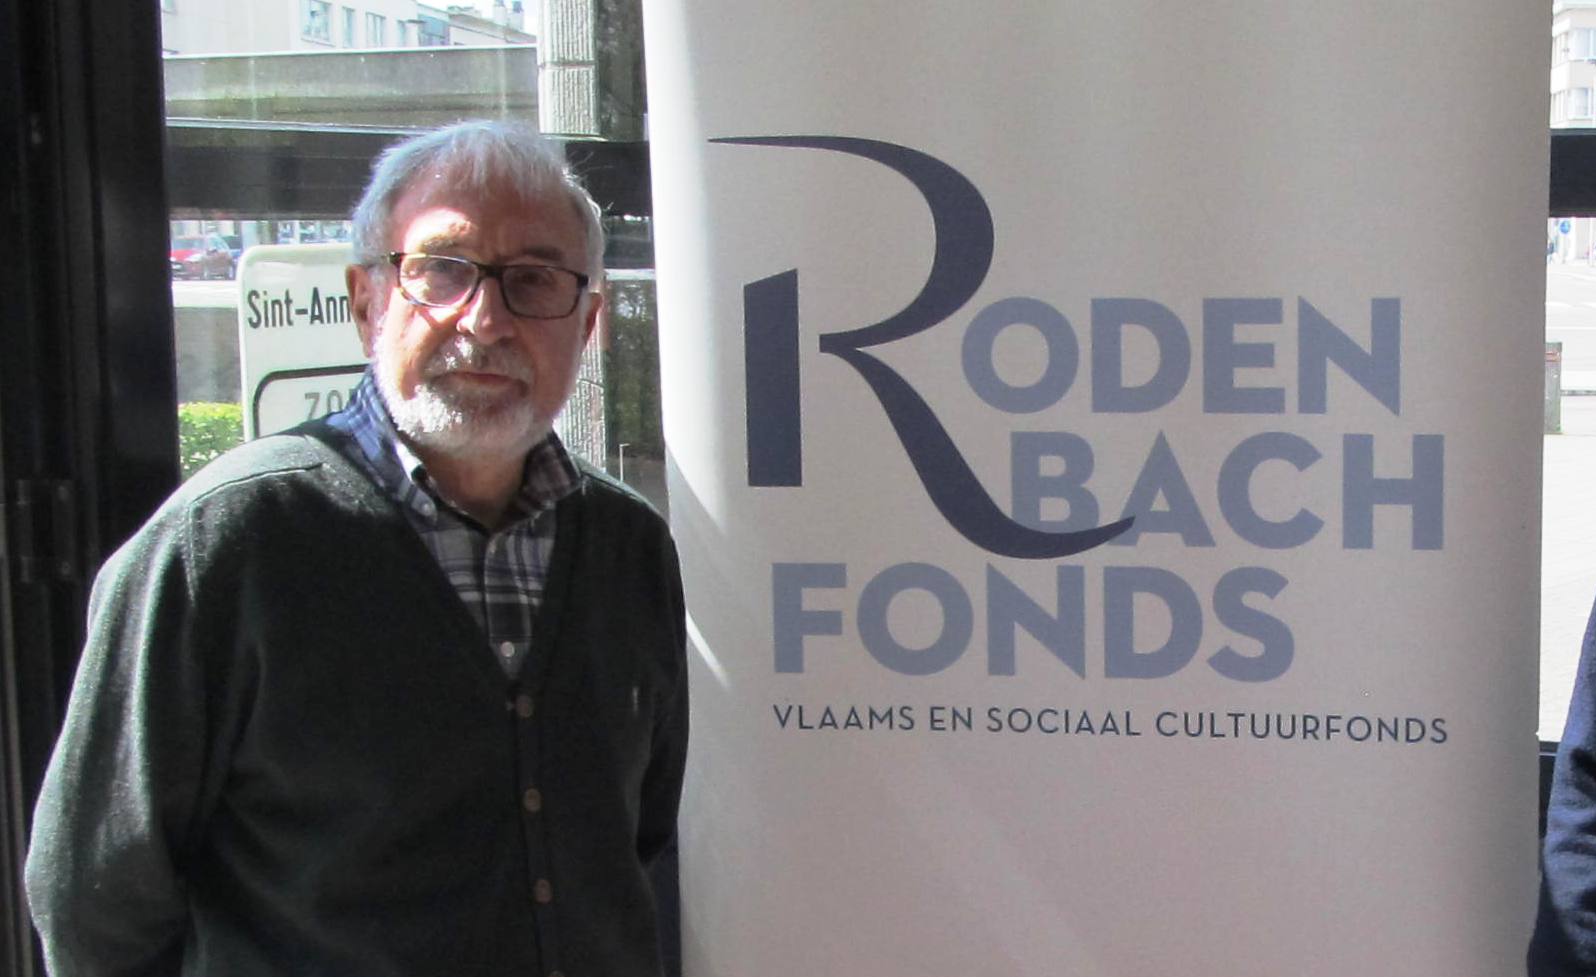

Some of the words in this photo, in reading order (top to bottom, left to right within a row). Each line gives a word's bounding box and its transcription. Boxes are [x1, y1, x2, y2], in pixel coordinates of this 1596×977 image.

[247, 286, 352, 329] Sint-Ann
[1009, 430, 1445, 551] BACH
[771, 561, 1296, 684] FONDS
[773, 704, 915, 733] VLAAMS
[929, 706, 974, 732] EN
[986, 707, 1142, 738] SOCIAAL
[1155, 710, 1449, 745] CULTUURFONDS
